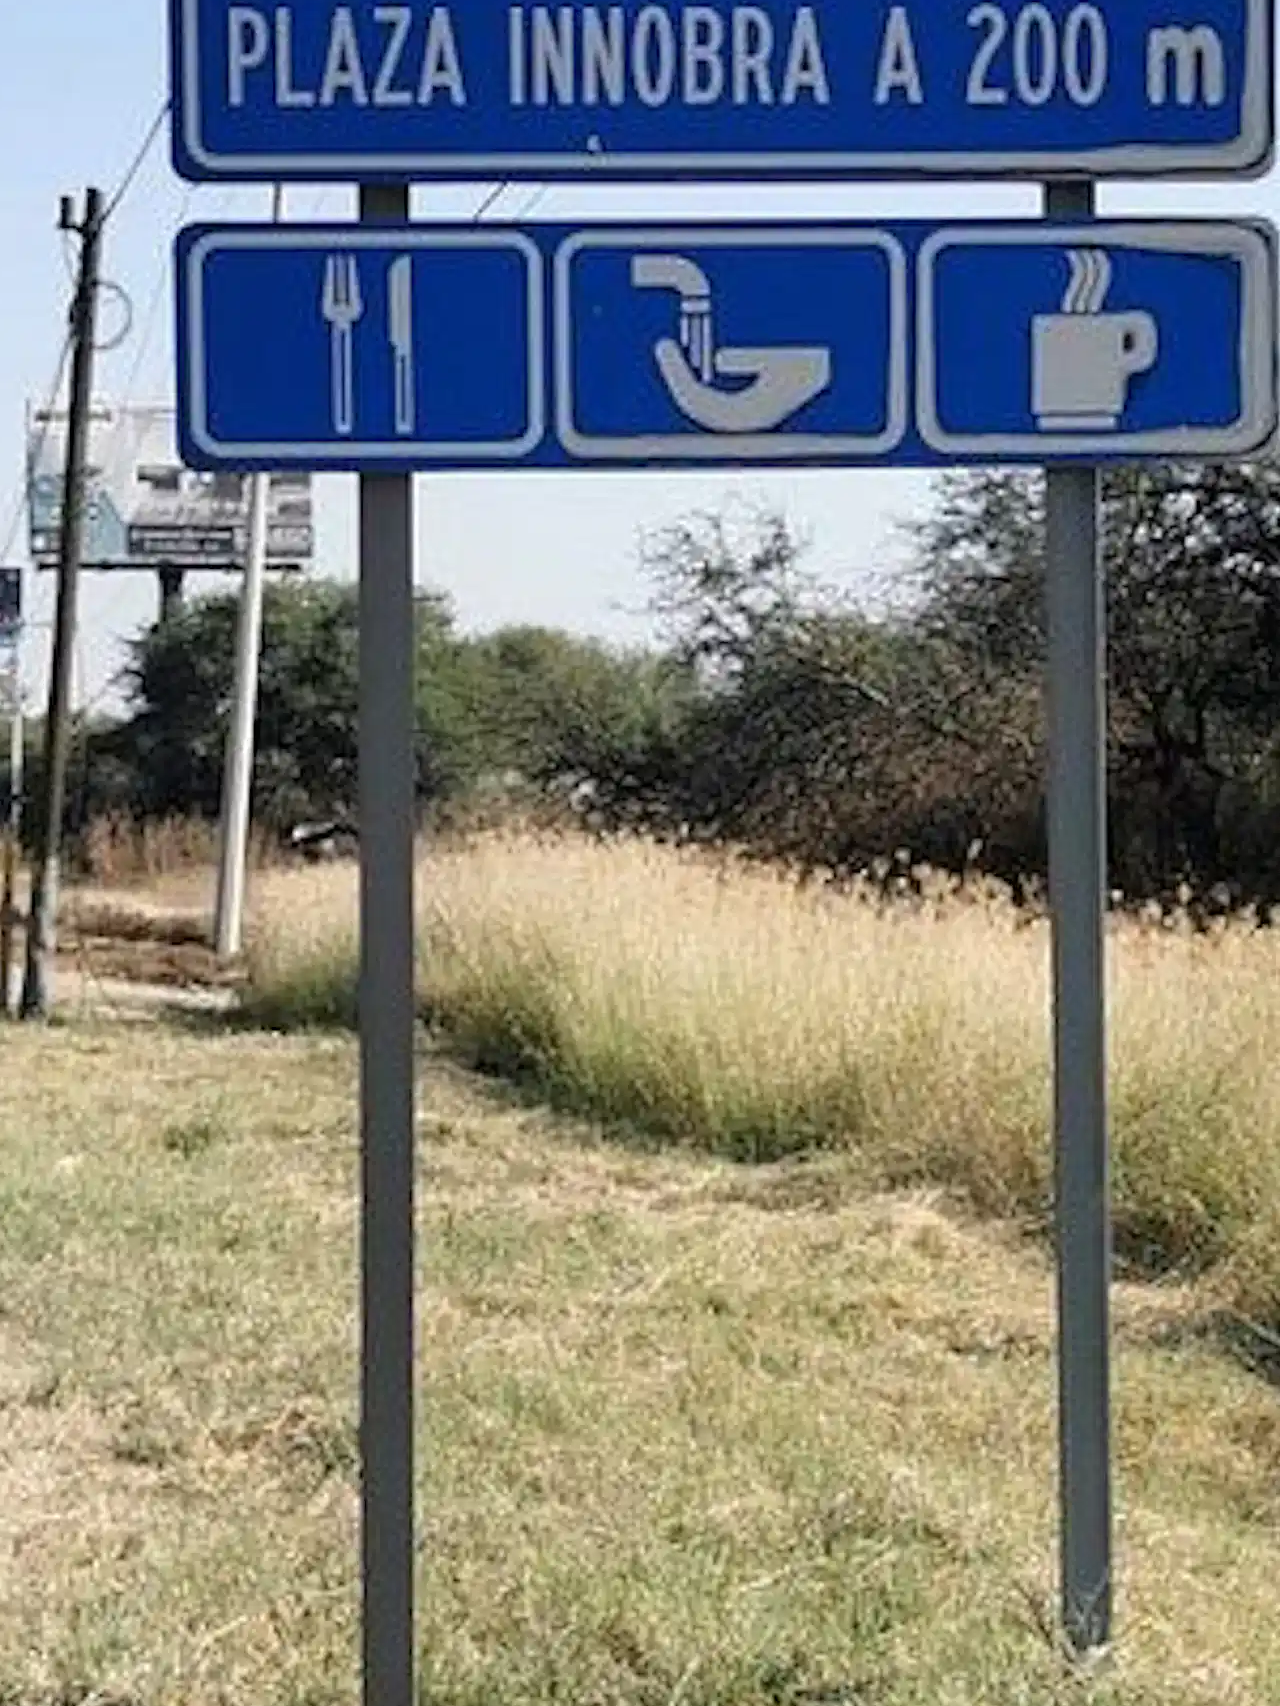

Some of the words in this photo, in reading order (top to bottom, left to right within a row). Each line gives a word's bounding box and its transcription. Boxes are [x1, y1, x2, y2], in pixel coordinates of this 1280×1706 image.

[227, 5, 467, 107] PLAZA
[508, 4, 830, 107] INNOBRA
[873, 5, 924, 105] A
[965, 1, 1108, 106] 200
[1145, 24, 1225, 107] m
